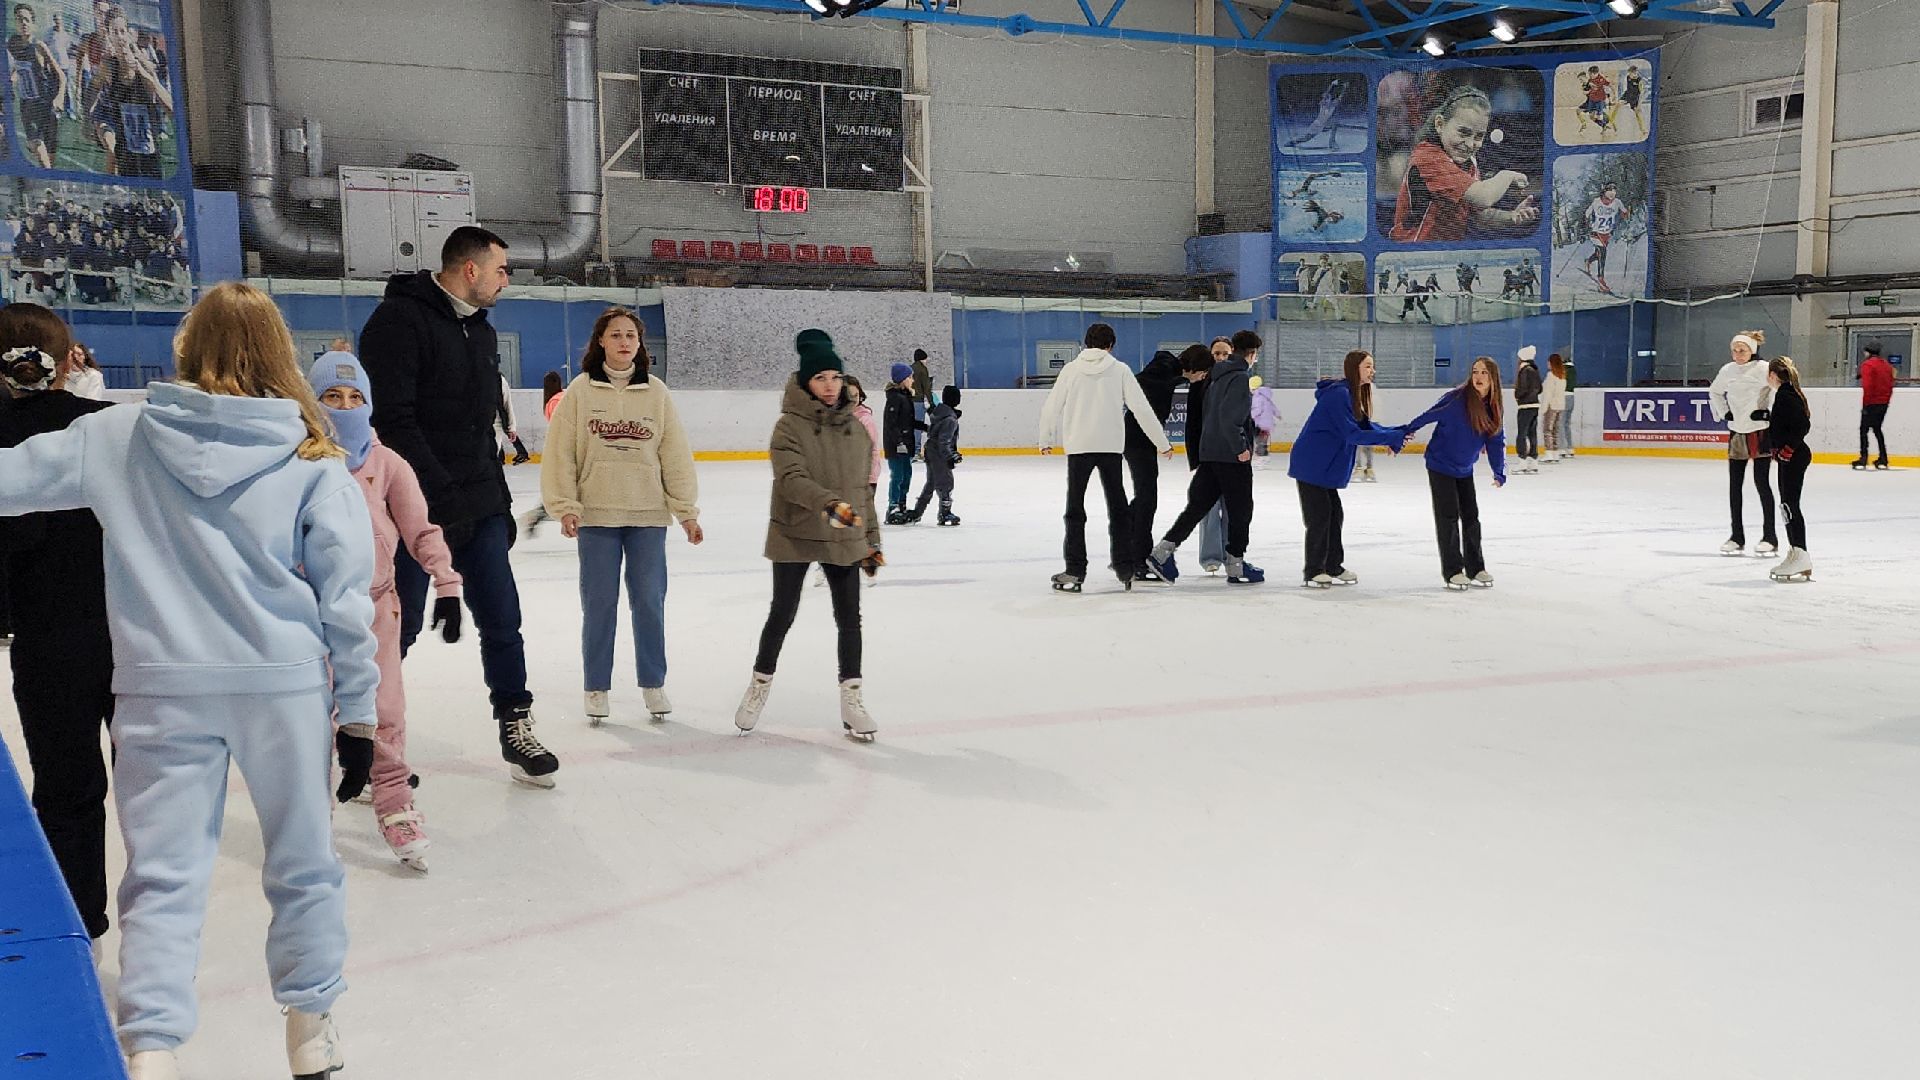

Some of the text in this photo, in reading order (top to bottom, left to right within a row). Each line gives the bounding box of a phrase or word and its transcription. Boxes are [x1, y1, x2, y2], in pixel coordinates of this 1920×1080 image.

[748, 86, 802, 101] ПЕРИОД
[654, 112, 716, 126] УДАЛЕНИЯ
[753, 129, 797, 142] ВРЕМЯ
[835, 124, 893, 137] УДАЛЕНИЯ
